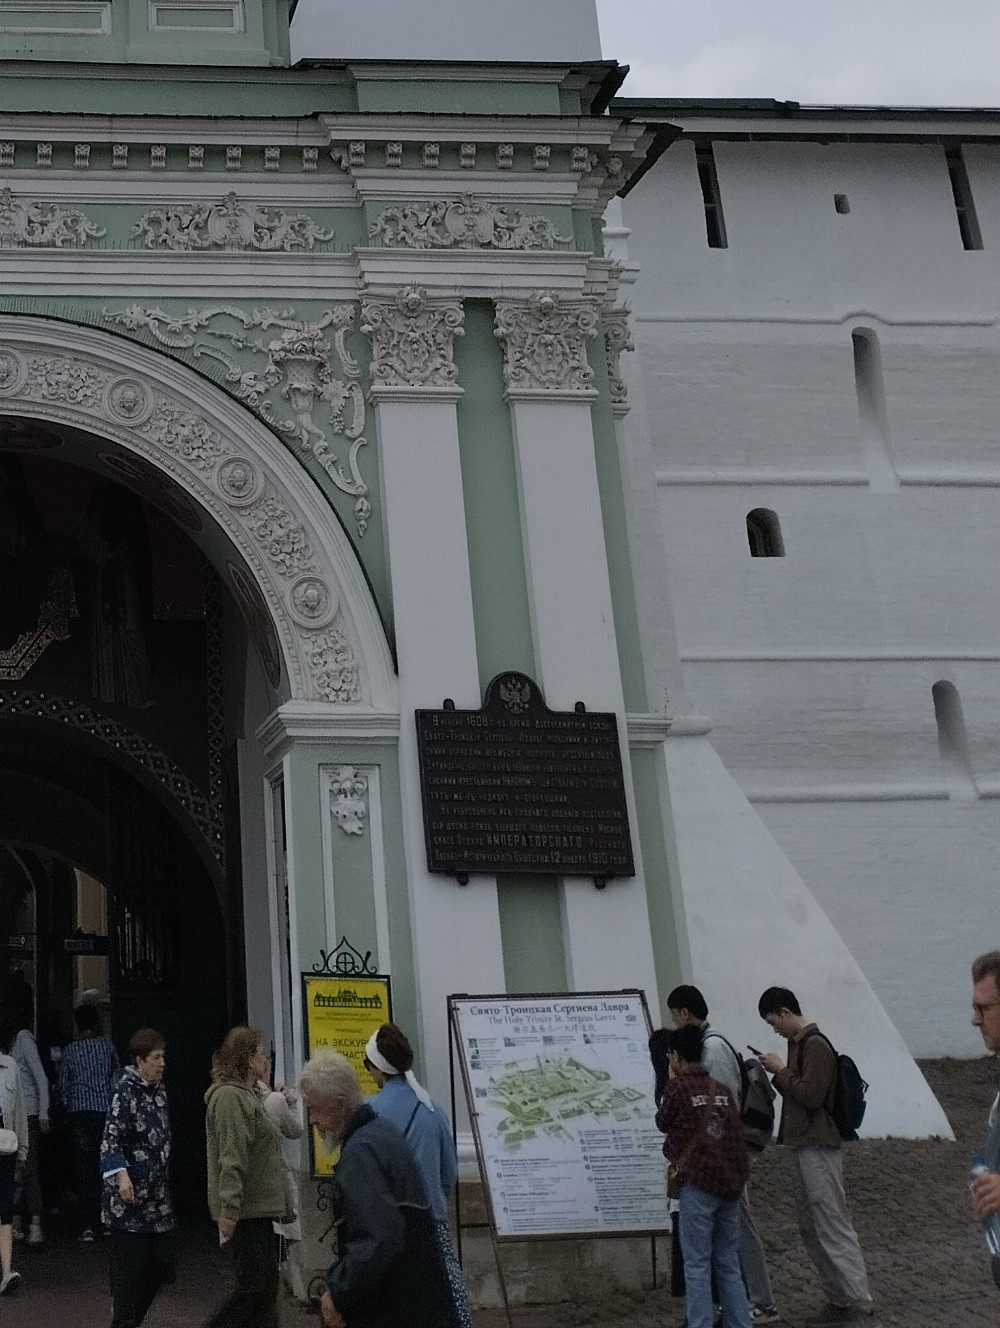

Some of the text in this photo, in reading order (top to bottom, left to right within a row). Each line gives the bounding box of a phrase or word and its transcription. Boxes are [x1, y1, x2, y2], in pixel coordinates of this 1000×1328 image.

[432, 714, 439, 726] 9
[466, 715, 488, 727] 1608
[486, 833, 582, 848] ИМПЕРАТОРСКАГО
[549, 850, 560, 863] 12
[587, 851, 607, 864] 1910
[470, 1002, 630, 1017] Свято-Троицкая Сергиева Лавра
[488, 1016, 504, 1024] The
[505, 1016, 523, 1025] Holy
[525, 1015, 552, 1024] Trinity
[316, 1038, 369, 1047] НА ЭКСКУР
